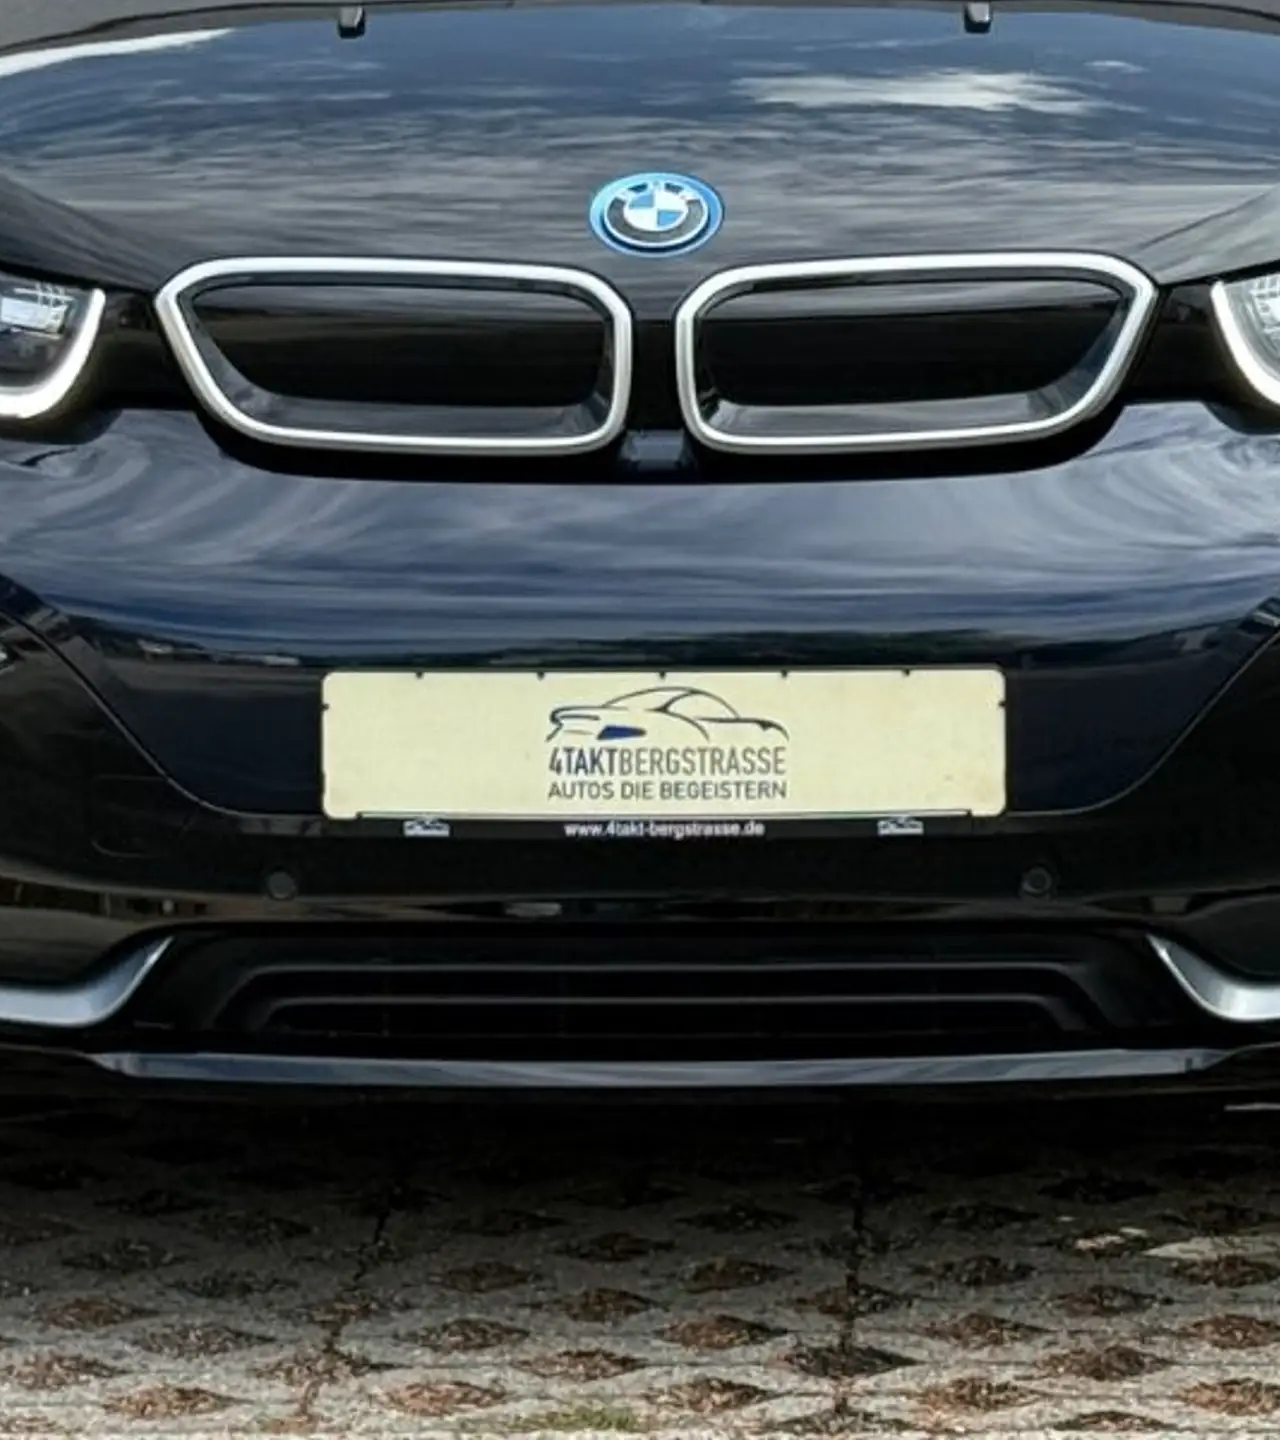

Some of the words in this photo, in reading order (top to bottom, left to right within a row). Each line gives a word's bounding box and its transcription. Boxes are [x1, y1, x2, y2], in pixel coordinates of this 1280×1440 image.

[548, 746, 787, 776] 4TAKTBERGSTRASSE
[547, 780, 614, 801] AUTOS
[620, 780, 654, 800] DIE
[659, 779, 788, 800] BEGEISTERN
[563, 820, 766, 841] www.4takt-bergstrasse.de
